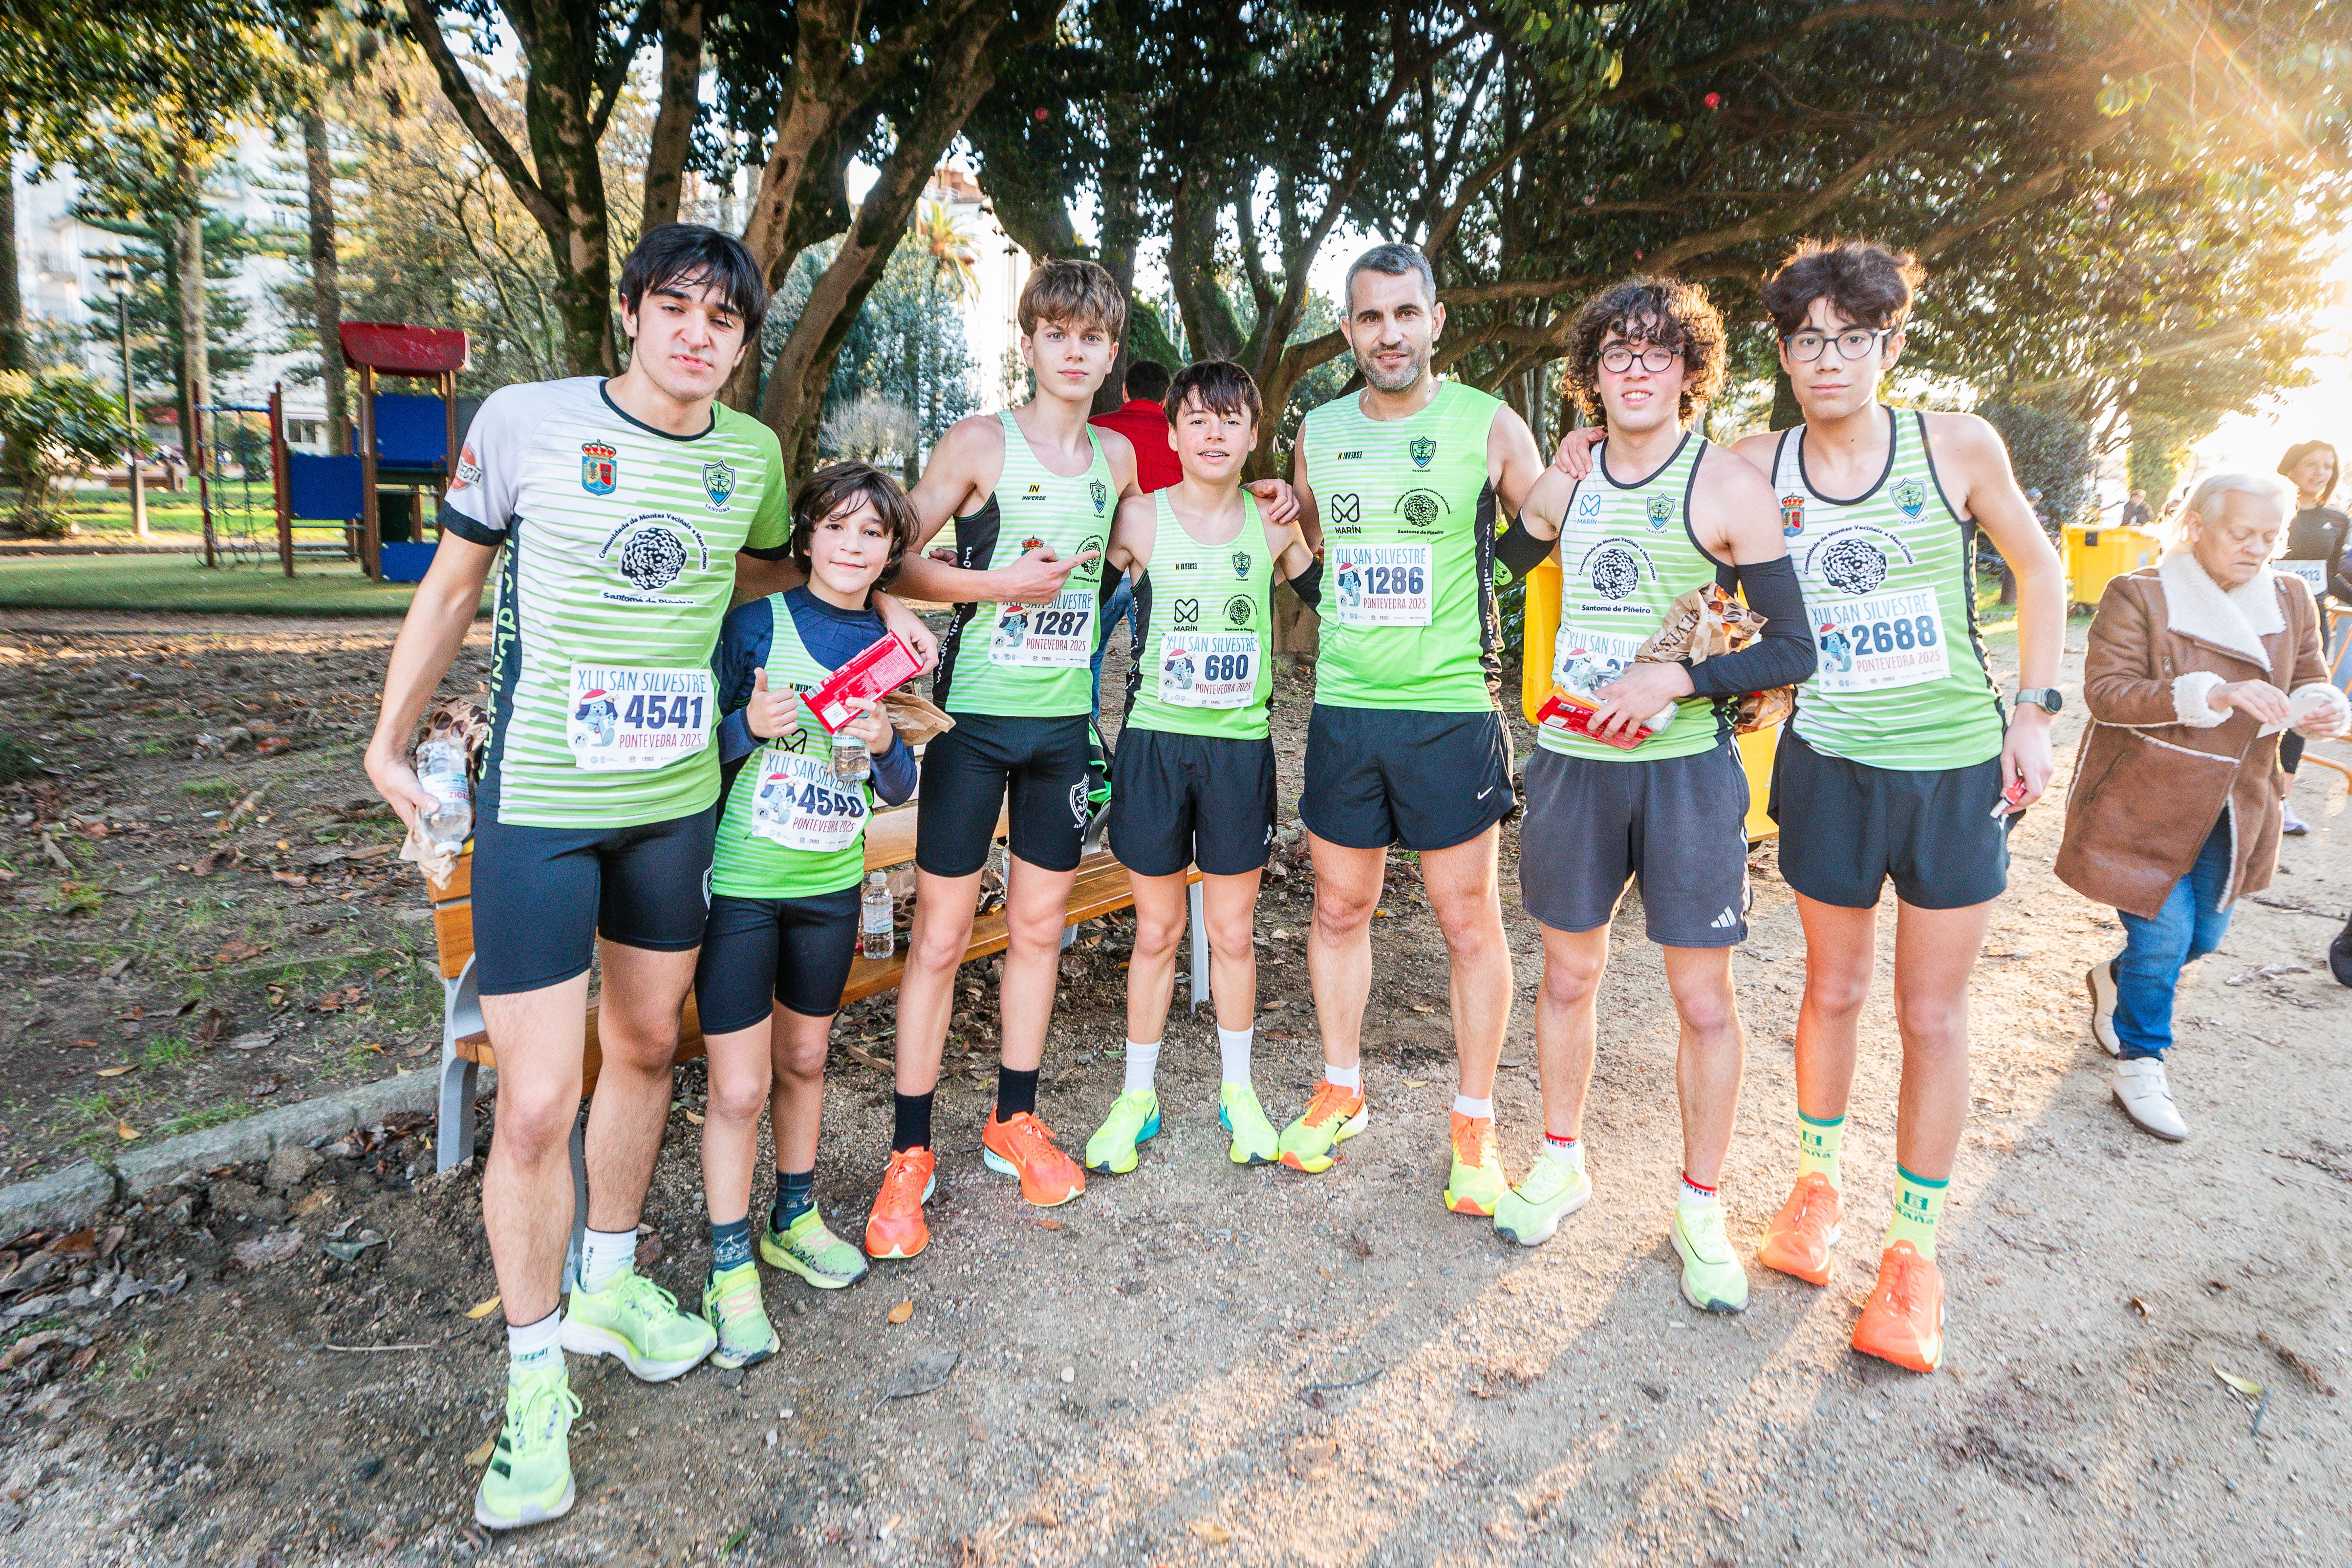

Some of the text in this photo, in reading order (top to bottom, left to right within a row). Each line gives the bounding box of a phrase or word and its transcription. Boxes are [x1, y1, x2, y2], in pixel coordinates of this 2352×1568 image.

[458, 460, 481, 484] ECTA
[705, 503, 730, 513] SANTOMÉ
[599, 522, 629, 558] Comunidade
[667, 514, 692, 529] Veciñais
[695, 533, 704, 547] Man
[1335, 525, 1361, 534] MARÍN
[1354, 549, 1371, 564] SAN
[1375, 549, 1426, 564] SILVESTRE
[1578, 547, 1596, 576] Comunidade
[1621, 537, 1639, 549] Veciñais
[1804, 541, 1820, 575] Comunidade
[1828, 526, 1853, 537] Montes
[1889, 534, 1901, 546] Man
[1365, 567, 1424, 594] 1286
[1364, 598, 1426, 609] PONTEVEDRA 2025
[1834, 604, 1860, 623] SAN
[1864, 594, 1930, 620] SILVESTRE
[1034, 611, 1089, 636] 1287
[1026, 638, 1086, 651] PONTEVEDRA 2025
[1188, 637, 1208, 652] SAN
[1212, 637, 1256, 652] SILVESTRE
[1589, 635, 1609, 654] SAN
[1852, 615, 1937, 655] 2688
[1205, 654, 1249, 681] 680
[1857, 650, 1941, 673] PONTEVEDRA 2025
[609, 671, 638, 691] SAN
[641, 672, 706, 692] SILVESTRE
[1195, 682, 1252, 694] PONTEVEDRA 2025
[625, 695, 703, 729] 4541
[619, 733, 702, 748] PONTEVEDRA 2025
[792, 759, 817, 780] SAN
[797, 783, 864, 818] 4540
[793, 817, 856, 833] PONTEVEDRA 2025
